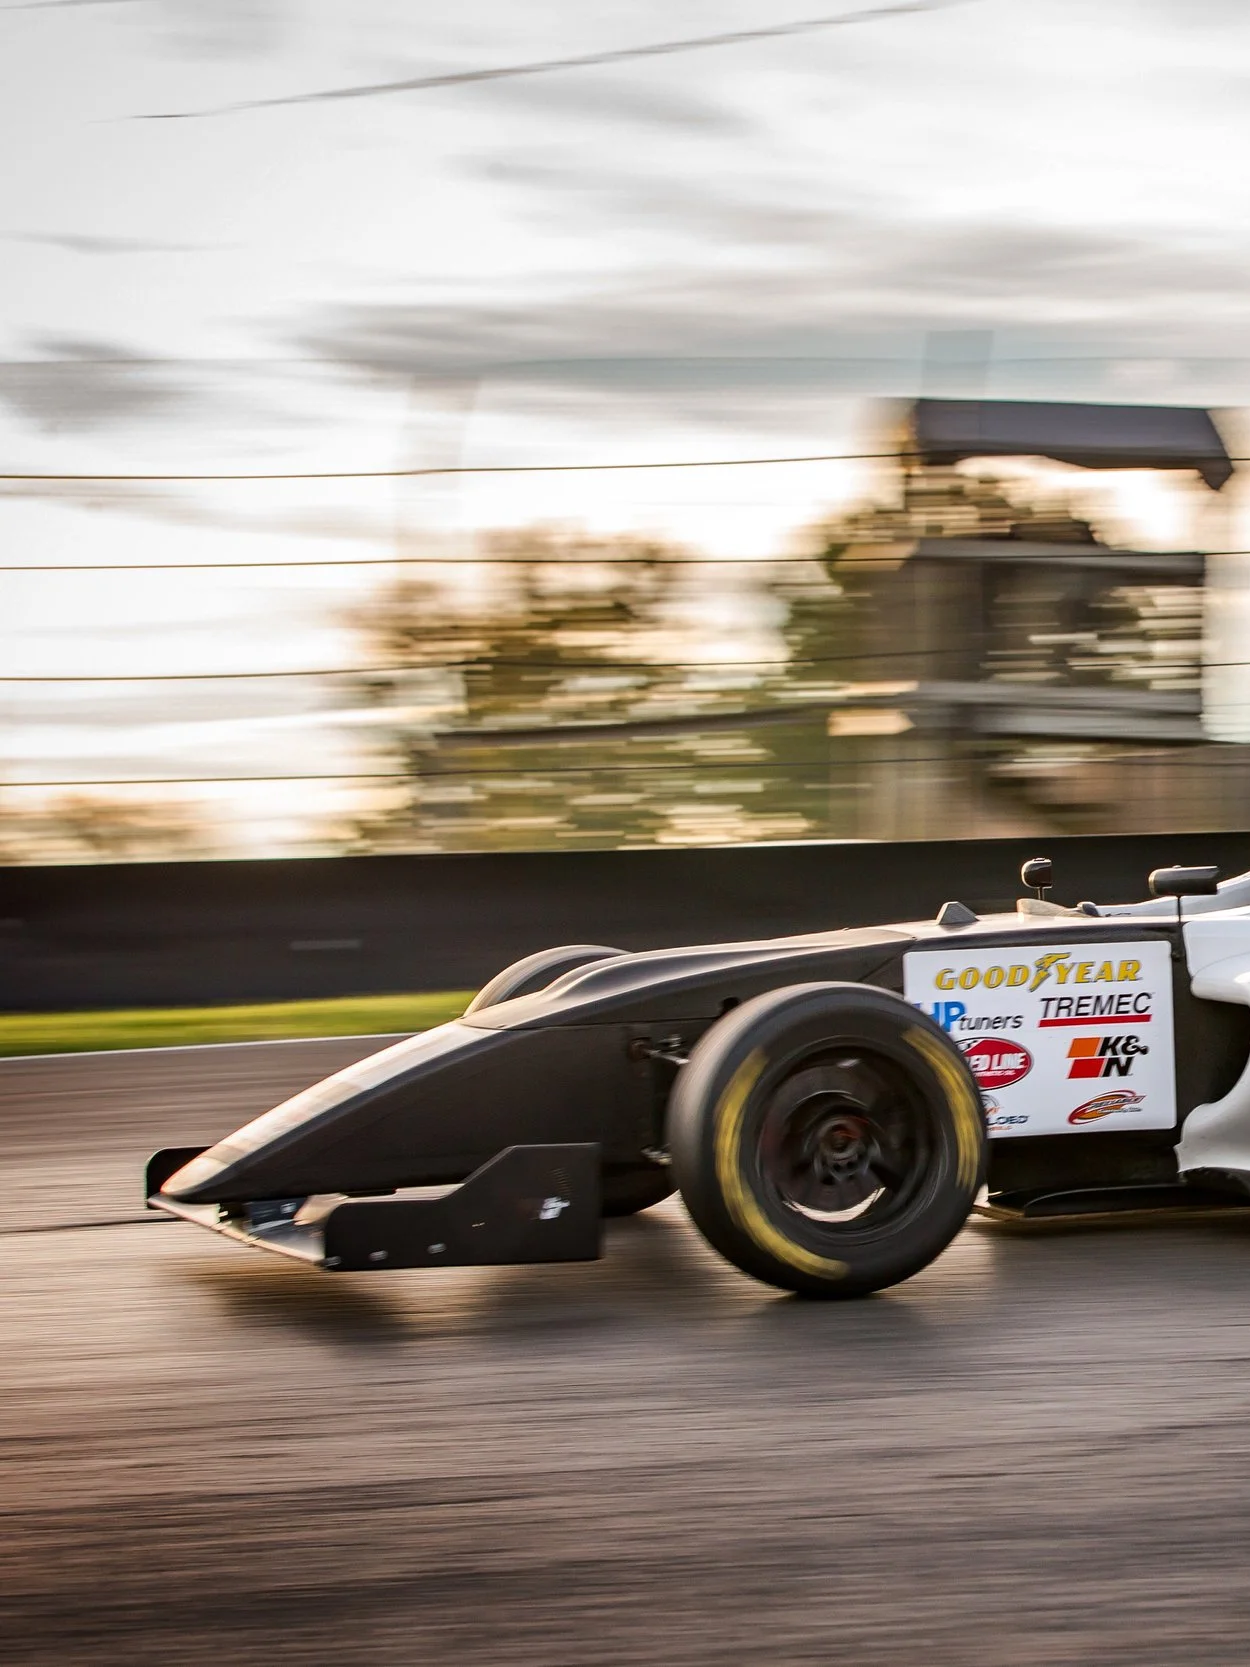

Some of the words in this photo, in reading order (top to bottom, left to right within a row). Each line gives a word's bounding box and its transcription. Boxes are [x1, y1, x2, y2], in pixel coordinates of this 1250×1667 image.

[934, 954, 1142, 991] GOODYEAR
[1040, 992, 1152, 1018] TREMEC
[959, 1015, 1024, 1030] tuners
